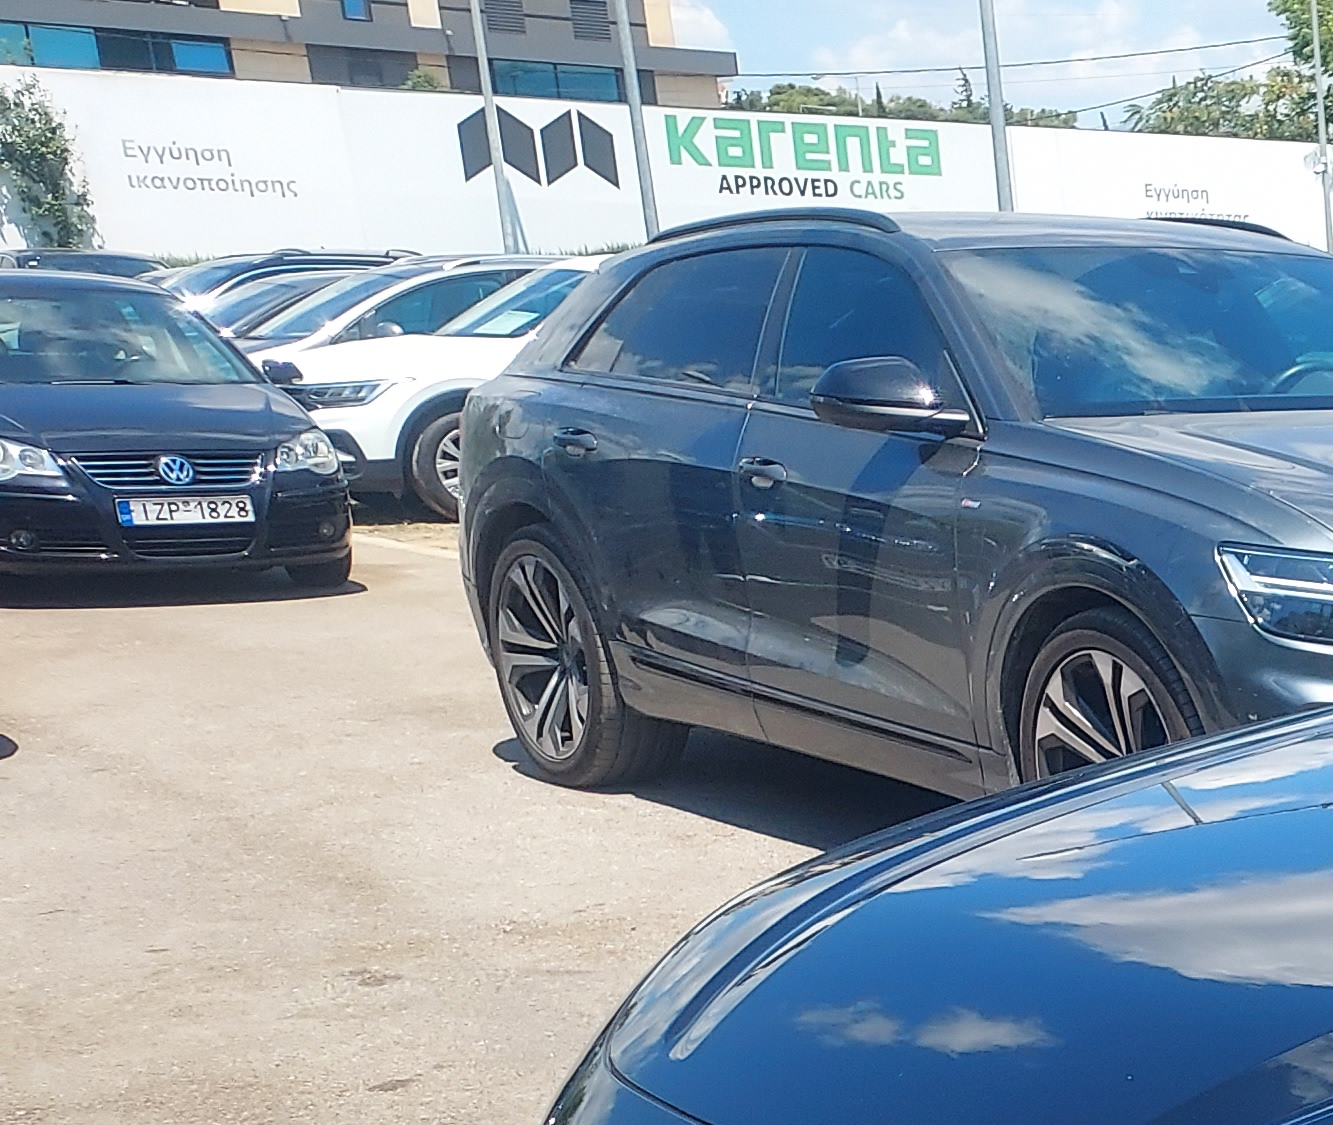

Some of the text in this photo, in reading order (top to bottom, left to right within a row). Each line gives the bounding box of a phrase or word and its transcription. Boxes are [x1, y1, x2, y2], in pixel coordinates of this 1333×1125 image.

[121, 138, 232, 167] Εγγύηση
[664, 114, 943, 176] karenta
[127, 172, 298, 198] ικανοποίησης
[718, 174, 905, 200] APPROVED CARS
[1144, 183, 1209, 204] Εγγύηση
